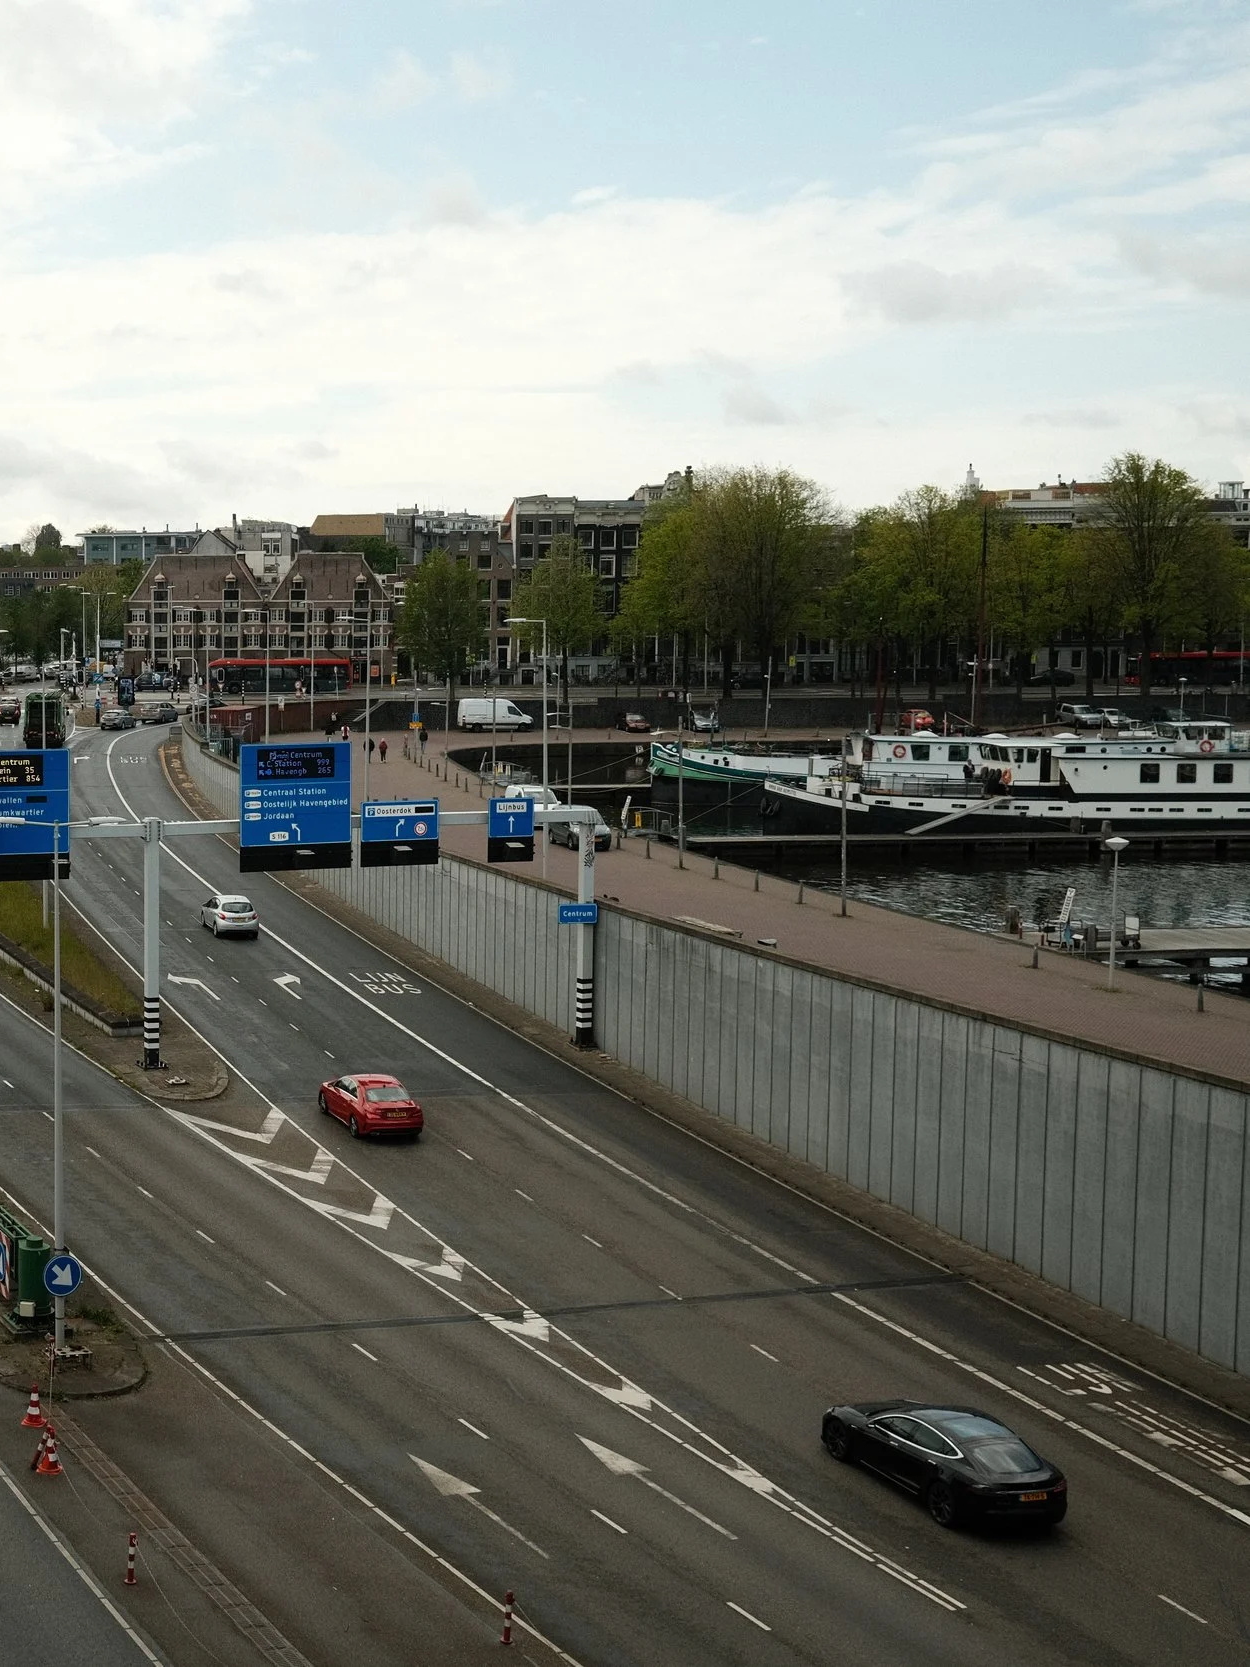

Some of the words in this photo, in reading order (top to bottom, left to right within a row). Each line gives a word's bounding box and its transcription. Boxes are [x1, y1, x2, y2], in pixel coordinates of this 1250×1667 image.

[317, 758, 330, 766] 999
[318, 766, 331, 774] 265
[263, 788, 296, 797] Centraal
[298, 787, 327, 796] Station
[263, 800, 297, 809] Oostelijk
[299, 798, 348, 808] Havengebied
[376, 807, 412, 815] Oosterdok
[498, 804, 525, 812] Lijnbus
[263, 812, 295, 820] Jordaan
[348, 972, 407, 983] LIJN
[363, 983, 422, 994] BUS
